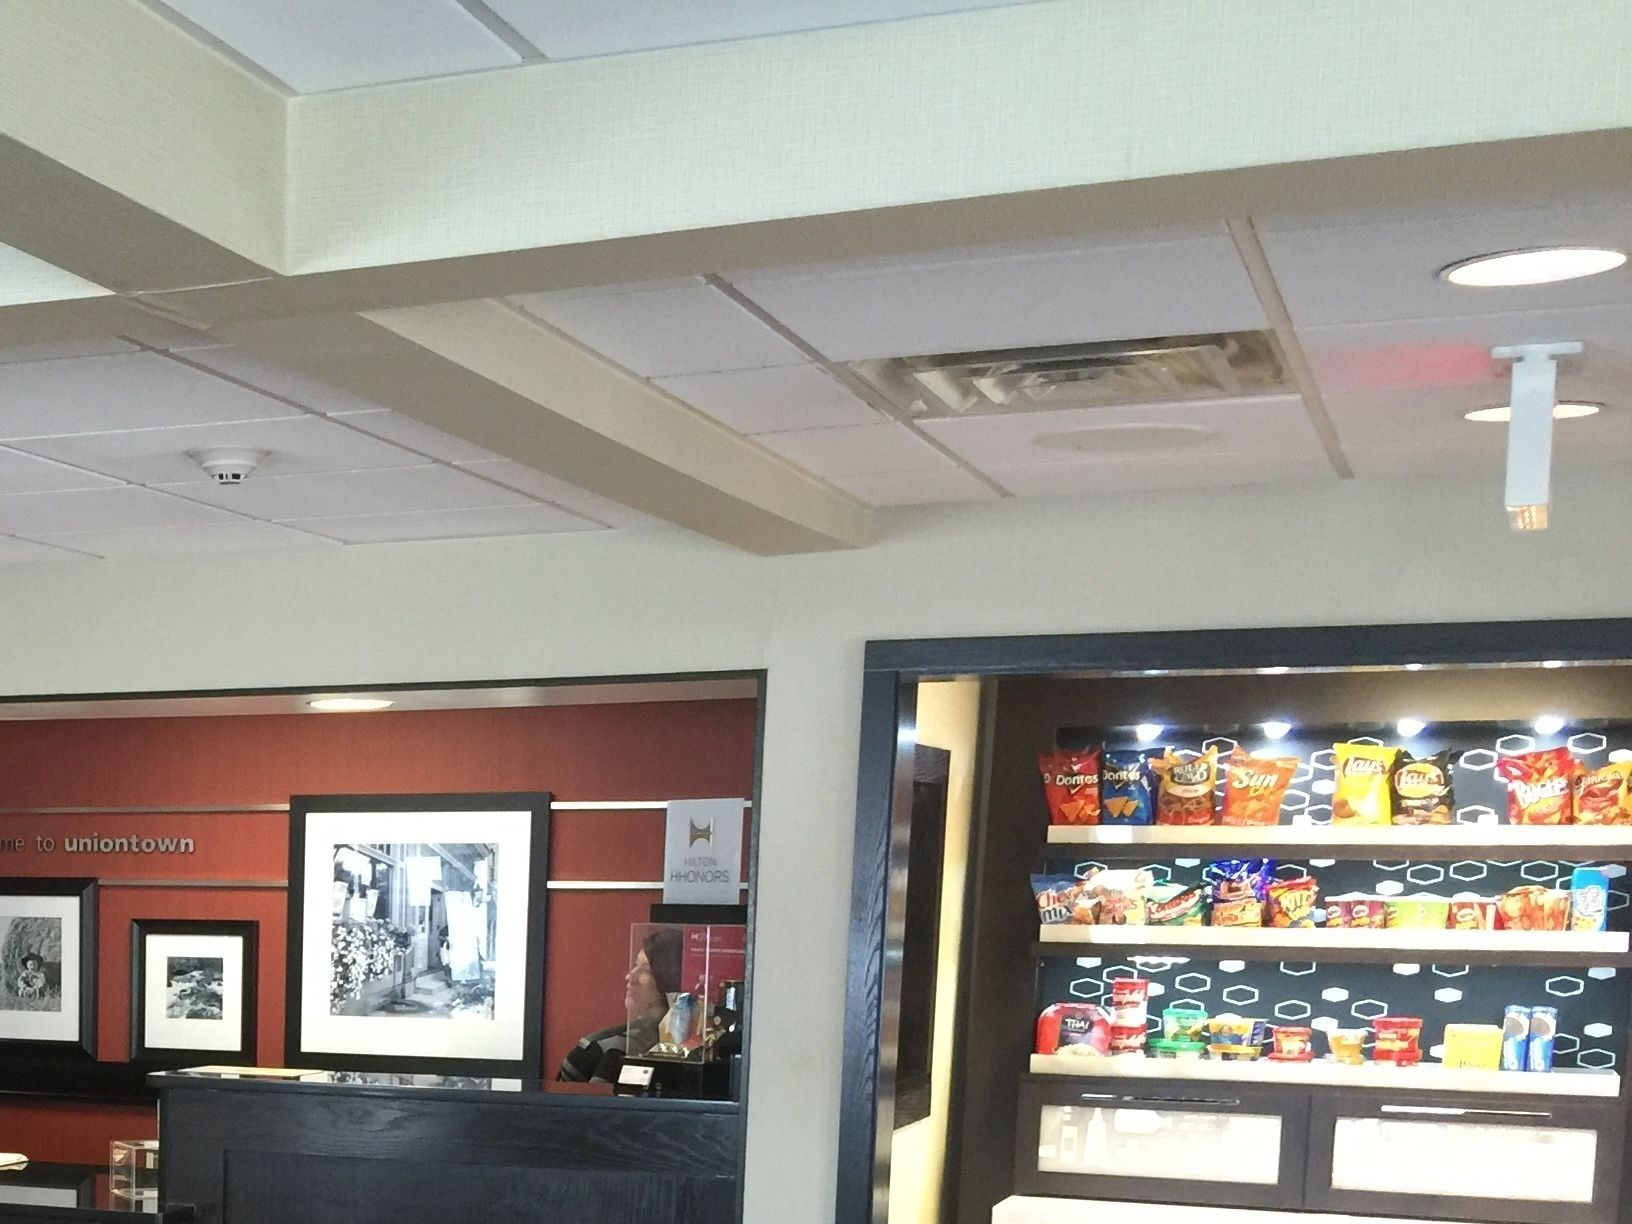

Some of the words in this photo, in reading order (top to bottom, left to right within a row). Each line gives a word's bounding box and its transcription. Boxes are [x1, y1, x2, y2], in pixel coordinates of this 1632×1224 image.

[1056, 774, 1099, 785] Doritos
[1231, 767, 1279, 789] Sun
[35, 834, 56, 852] to
[64, 832, 195, 853] uniontown
[669, 870, 731, 883] HHONORS
[1065, 1018, 1090, 1030] THAI
